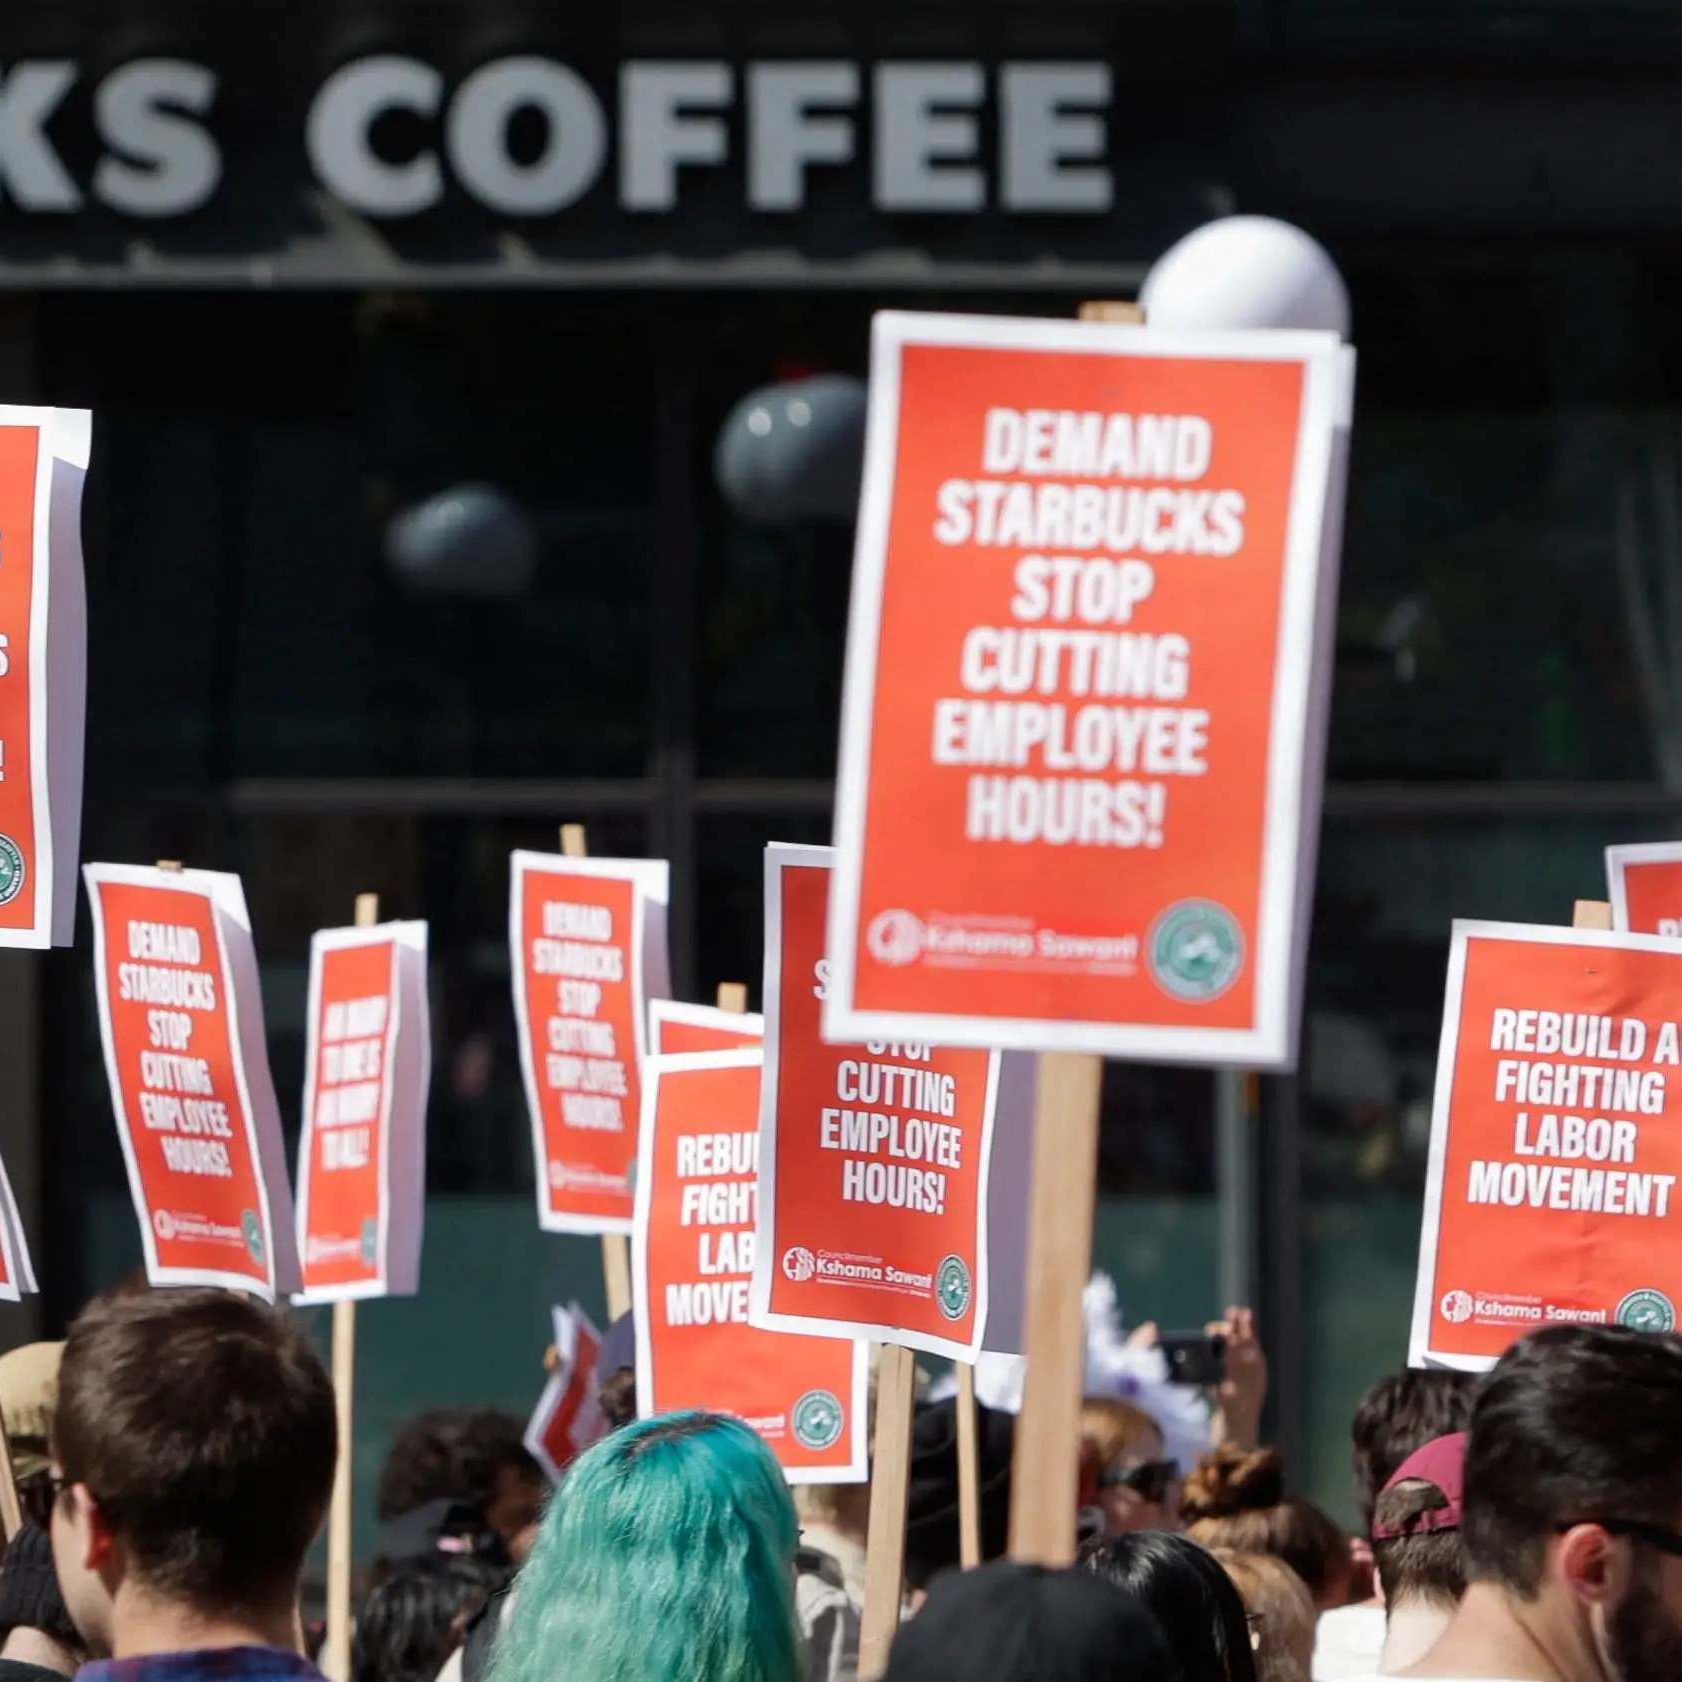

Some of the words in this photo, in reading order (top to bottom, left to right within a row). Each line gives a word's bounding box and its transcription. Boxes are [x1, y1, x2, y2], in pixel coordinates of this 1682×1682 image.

[305, 55, 1112, 217] COFFEE
[982, 406, 1213, 482] DEMAND
[932, 477, 1246, 557] STARBUCKS
[1009, 554, 1155, 626] STOP
[960, 625, 1191, 701] CUTTING
[931, 697, 1211, 776] EMPLOYEE
[965, 773, 1167, 849] HOURS!
[128, 919, 201, 966] DEMAND
[119, 962, 216, 1011] STARBUCKS
[147, 1008, 193, 1052] STOP
[1490, 1007, 1648, 1062] REBUILD
[1652, 1021, 1680, 1066] A
[139, 1091, 234, 1138] EMPLOYEE
[837, 1059, 956, 1117] CUTTING
[1495, 1059, 1666, 1115] FIGHTING
[820, 1108, 963, 1169] EMPLOYEE
[1514, 1112, 1638, 1164] LABOR
[843, 1159, 946, 1216] HOURS!
[1467, 1160, 1677, 1218] MOVEMENT
[817, 1259, 882, 1280] Kshama
[885, 1267, 933, 1289] Sawant
[1474, 1300, 1542, 1320] Kshama
[1543, 1305, 1608, 1325] Sawant
